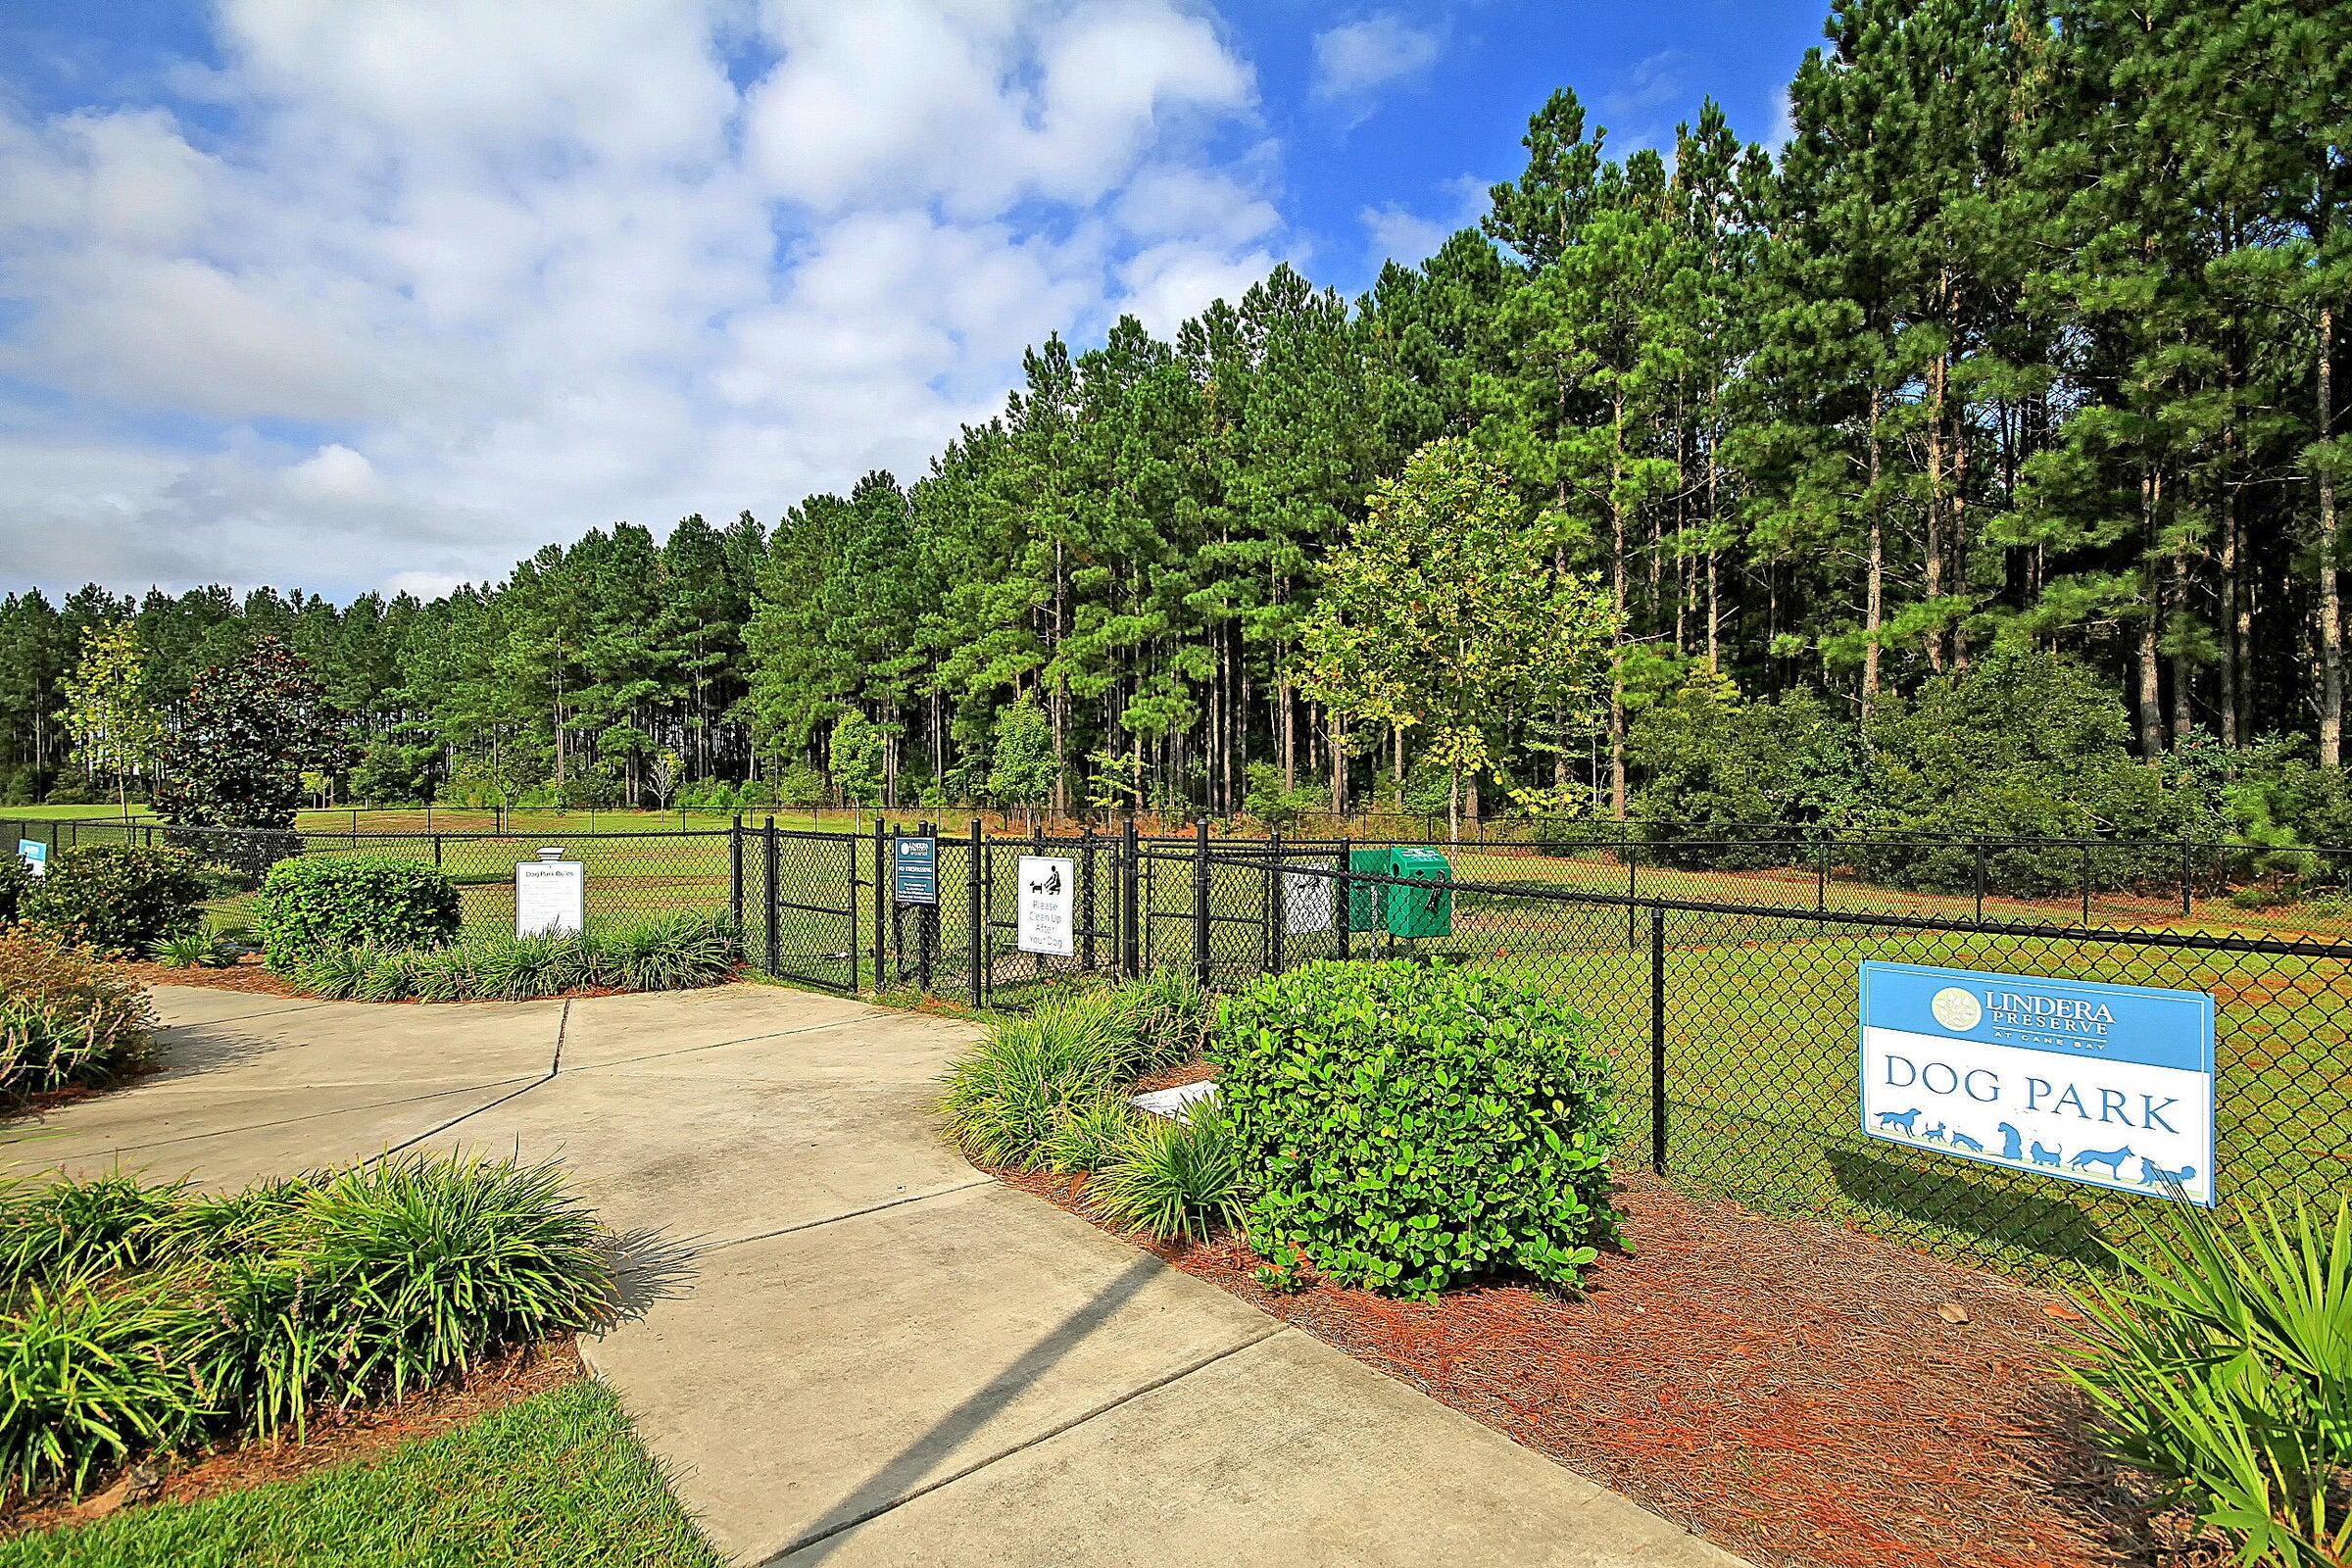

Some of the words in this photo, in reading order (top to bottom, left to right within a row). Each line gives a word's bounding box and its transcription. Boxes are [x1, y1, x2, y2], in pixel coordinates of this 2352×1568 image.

[1033, 900, 1057, 911] Please
[1029, 911, 1050, 922] Clean
[1052, 913, 1061, 924] Up
[1048, 936, 1062, 949] Dog
[1984, 991, 2117, 1024] LINDERA
[1992, 1010, 2108, 1035] PRESERVE
[2022, 1035, 2064, 1046] CANE
[2074, 1041, 2105, 1051] BAY
[1885, 1054, 2001, 1102] DOG
[2025, 1076, 2180, 1135] PARK
